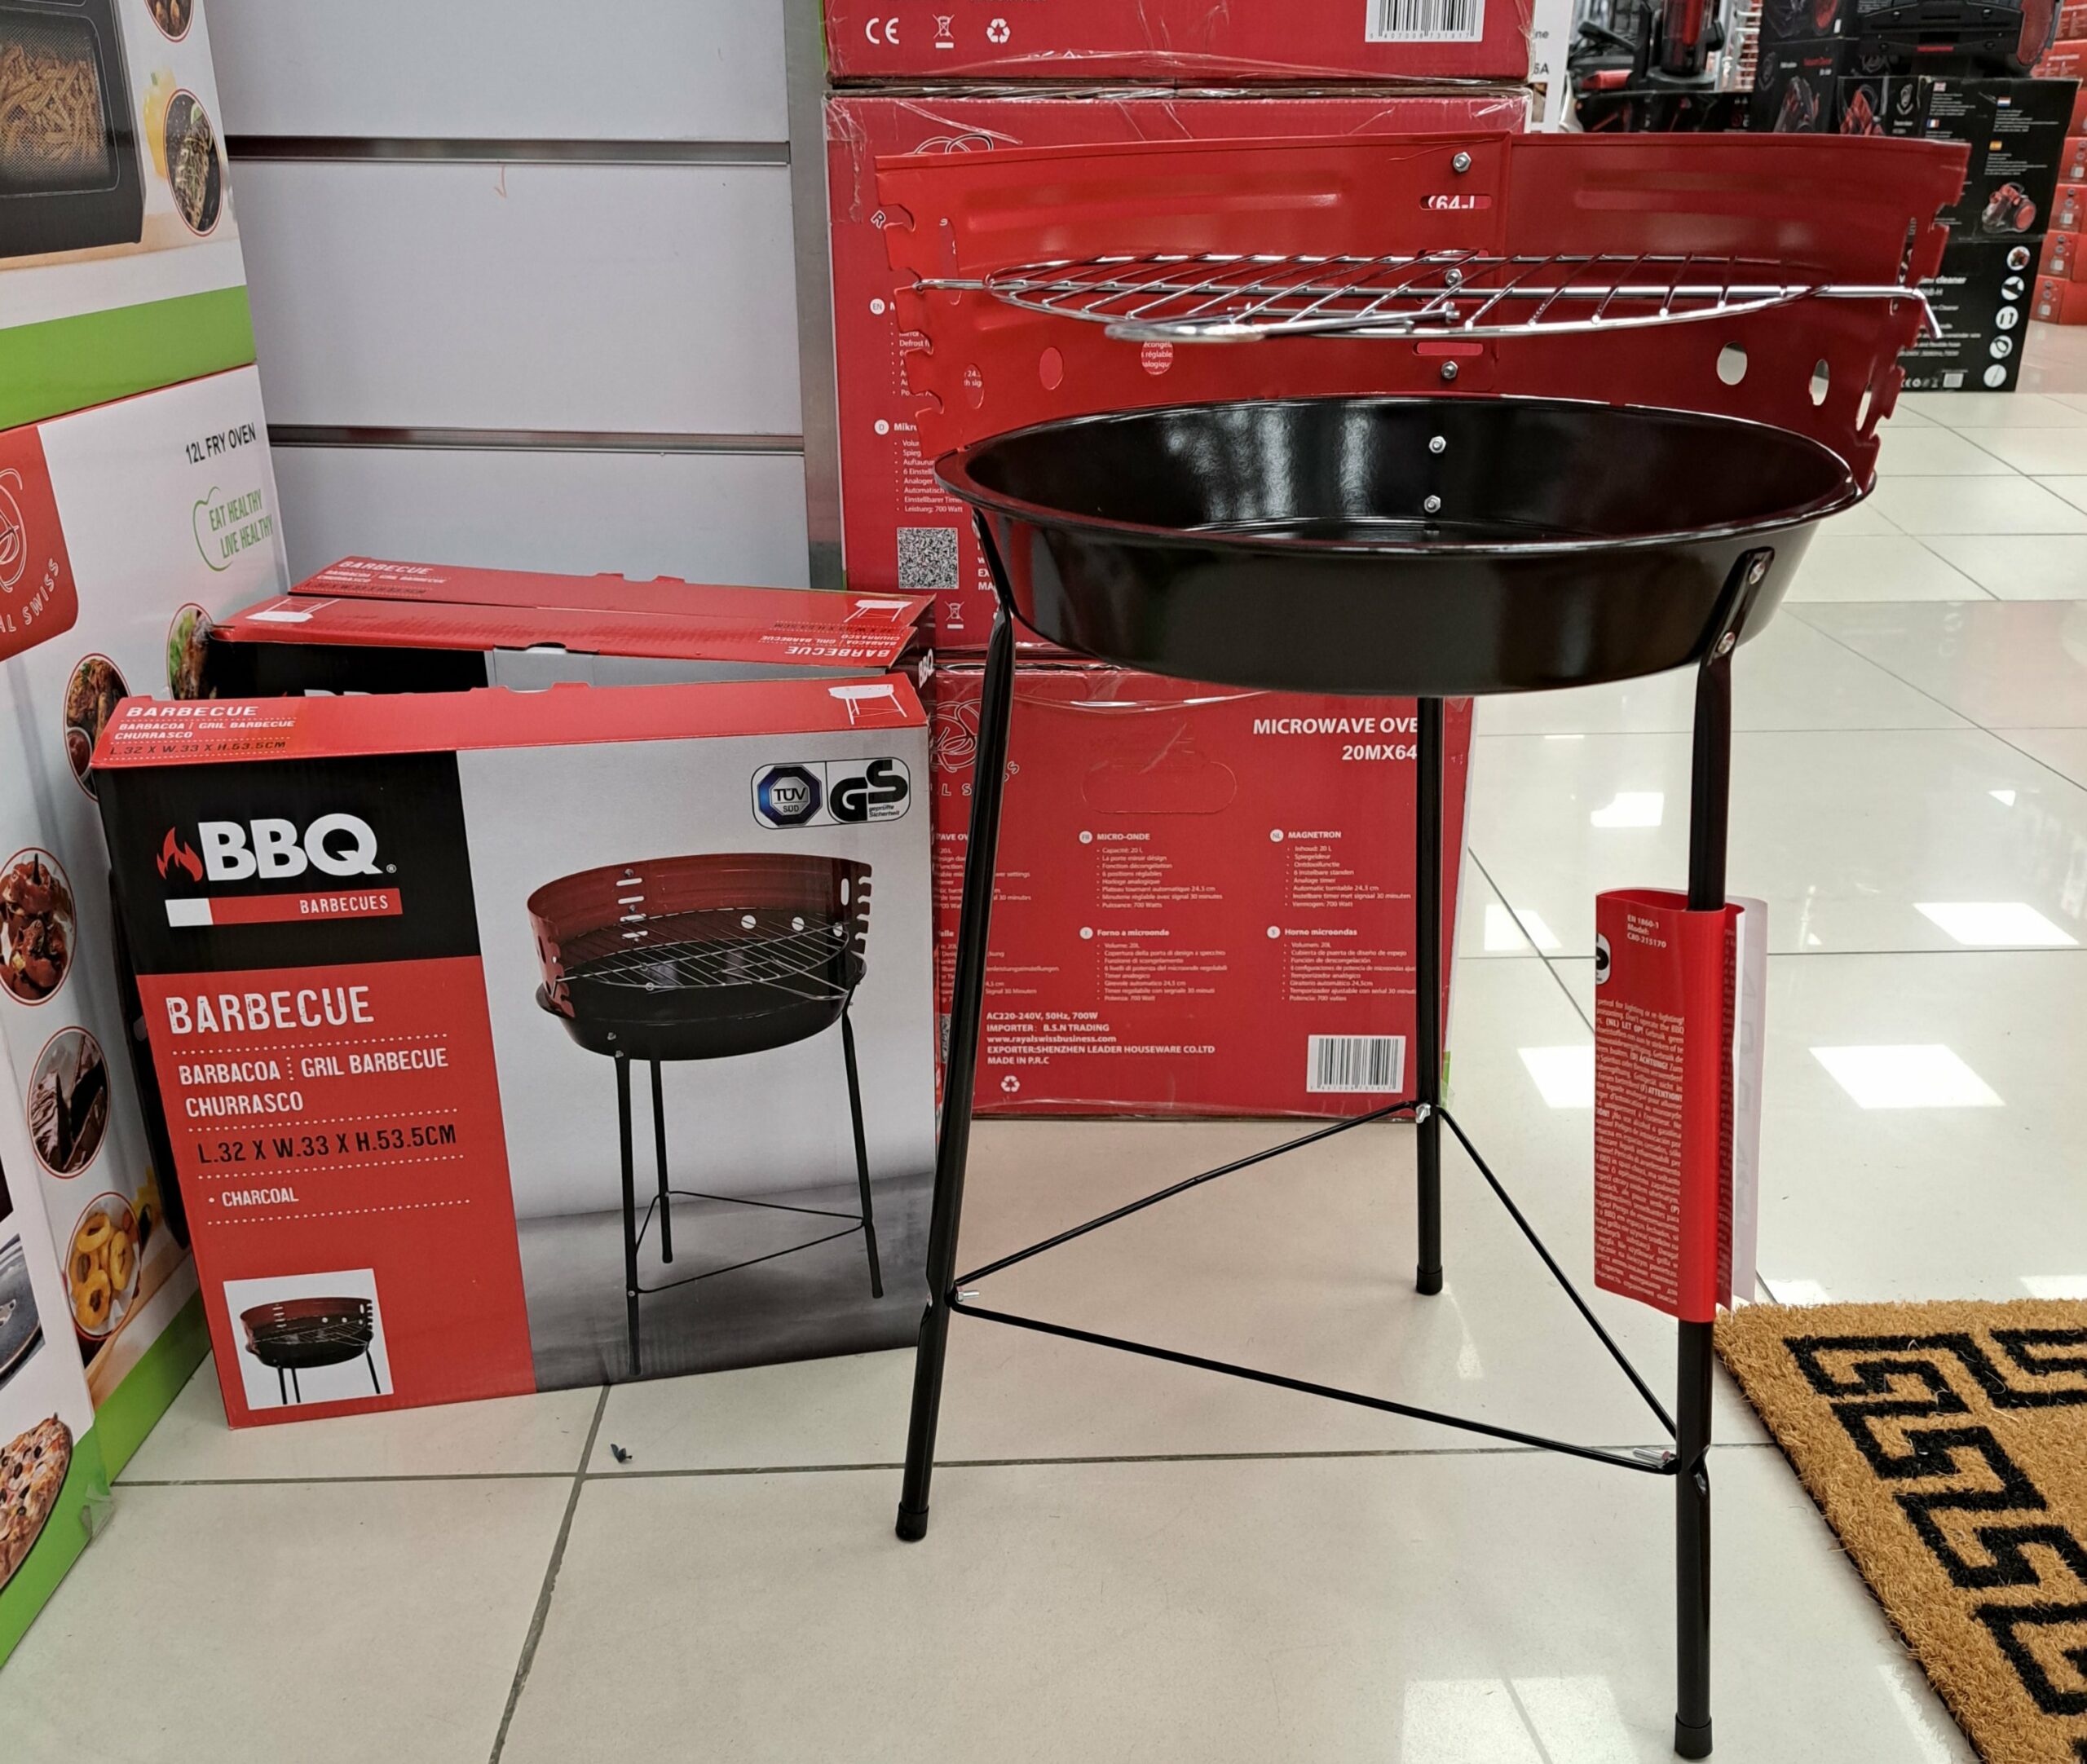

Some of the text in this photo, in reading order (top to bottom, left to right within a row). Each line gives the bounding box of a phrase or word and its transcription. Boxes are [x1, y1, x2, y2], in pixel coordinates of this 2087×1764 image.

[186, 422, 257, 465] 12L FRY OVEN
[209, 489, 263, 531] EAT HEALTHY
[220, 514, 274, 560] LIVE HEALTHY
[339, 561, 434, 575] BARBECUE
[24, 558, 60, 625] SWISS
[785, 646, 891, 658] BARBECUE
[918, 648, 935, 690] BBQ
[126, 706, 259, 718] BARBECUE
[119, 720, 295, 731] BARBACOA GRIL BARBECUE
[1253, 717, 1417, 735] MICROWAVE OVE
[114, 730, 193, 741] CHURRASCO
[109, 745, 143, 756] L.32
[162, 744, 199, 755] W.33
[773, 787, 806, 802] TÜV
[1096, 832, 1150, 840] MICRO-ONDE
[1288, 830, 1342, 839] MAGNETRON
[197, 813, 383, 881] BBQ
[299, 894, 389, 915] BARBECUES
[1096, 928, 1170, 937] Forno microonde
[1285, 928, 1357, 937] Horno microondas
[165, 986, 375, 1034] BARBECUE
[1072, 1012, 1099, 1020] 700W
[1043, 1024, 1066, 1032] B.S.N
[1068, 1024, 1110, 1032] TRADING
[1087, 1045, 1123, 1054] LEADER
[1124, 1045, 1182, 1054] HOUSEWARE
[1183, 1045, 1215, 1054] CO.LTD
[179, 1047, 449, 1087] BARBACOA GRIL BARBECUE
[987, 1056, 1050, 1065] MADE IN P.R.C
[184, 1091, 304, 1118] CHURRASCO
[197, 1123, 457, 1165] L.32 X W.33 X H.53.5CM
[221, 1186, 300, 1208] CHARCOAL
